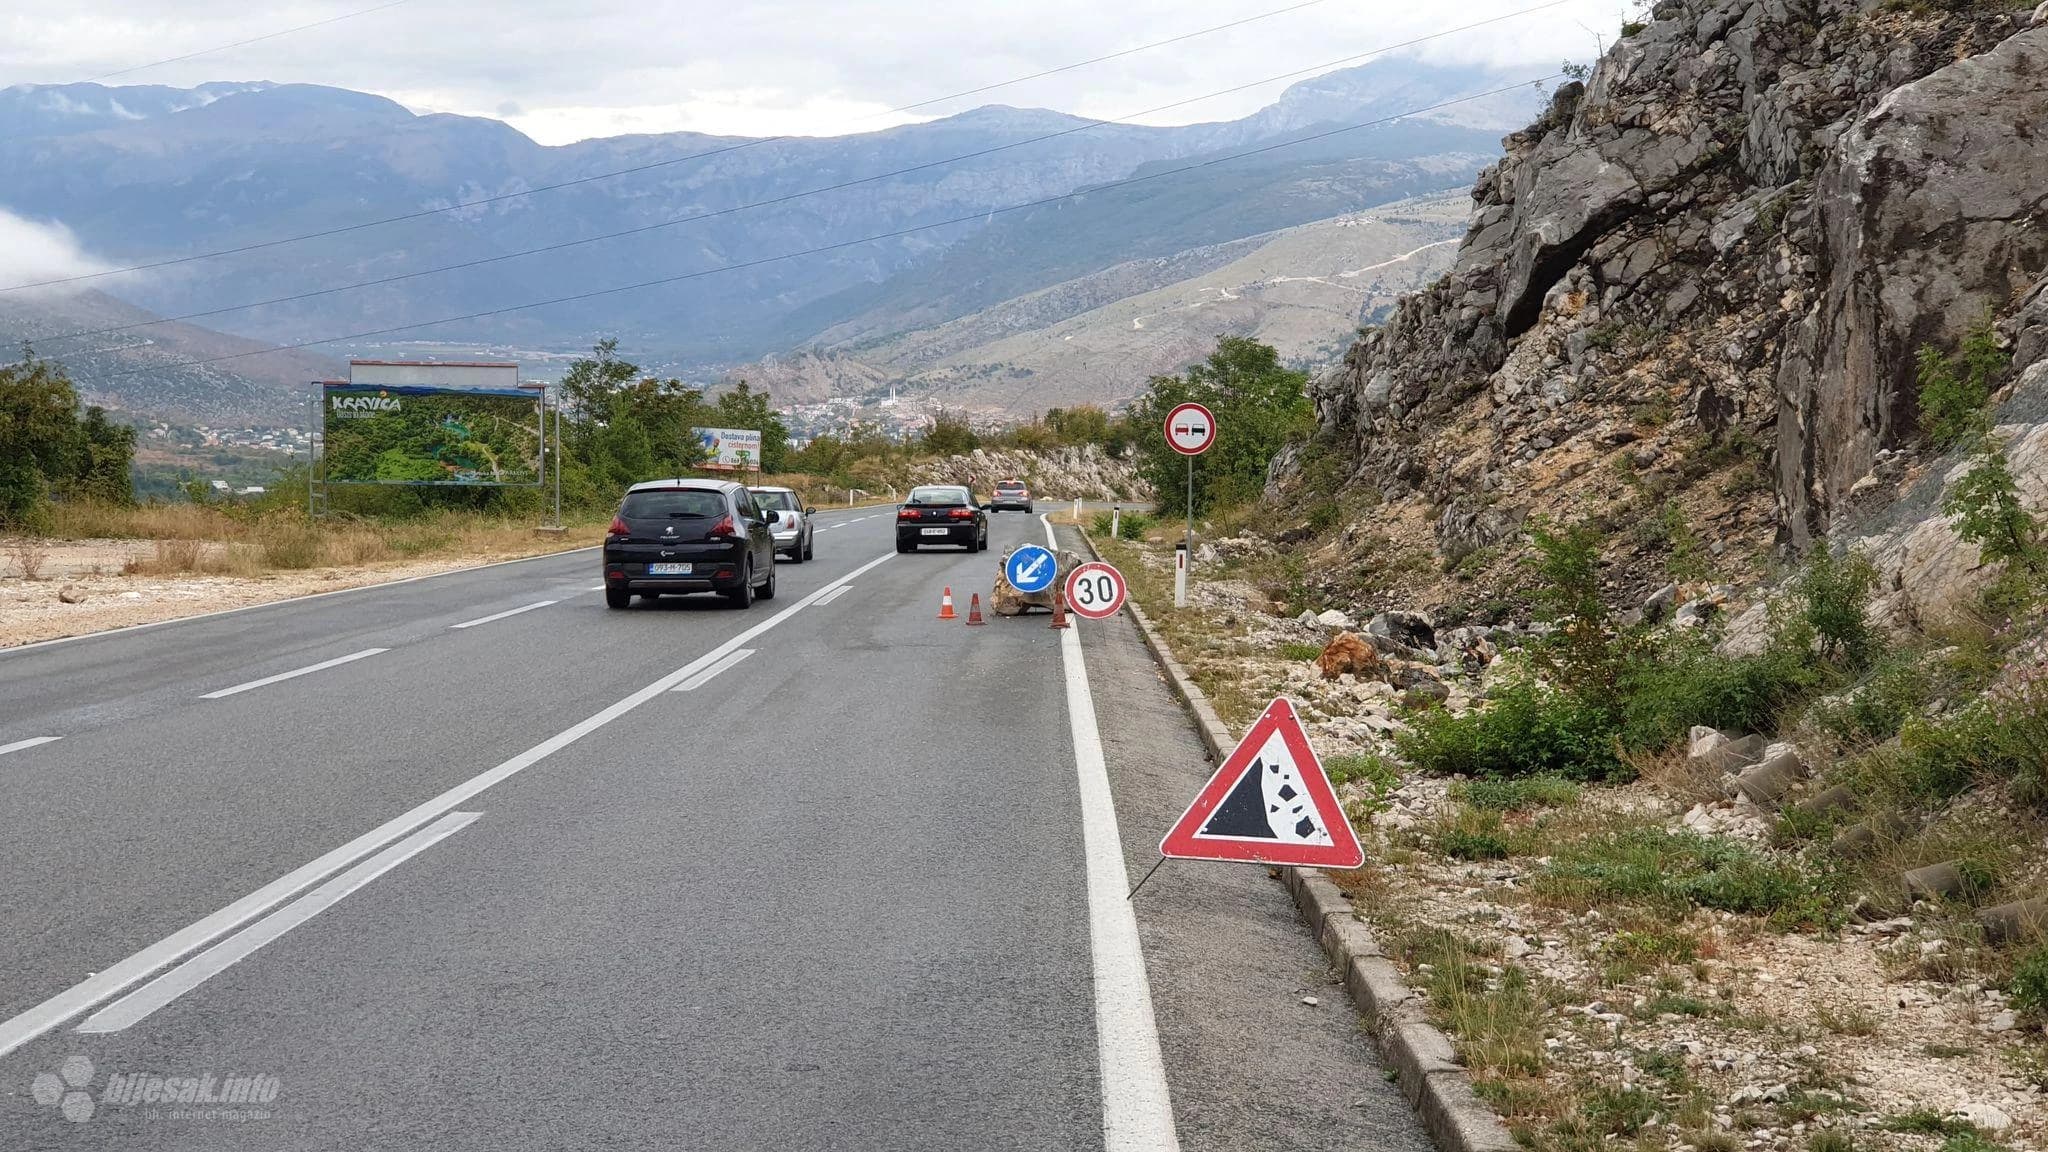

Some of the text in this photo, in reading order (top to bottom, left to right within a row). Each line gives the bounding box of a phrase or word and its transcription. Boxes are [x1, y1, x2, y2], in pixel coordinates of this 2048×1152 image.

[332, 396, 401, 412] KRAVICA
[721, 432, 744, 440] Dostava
[1078, 575, 1114, 605] 30
